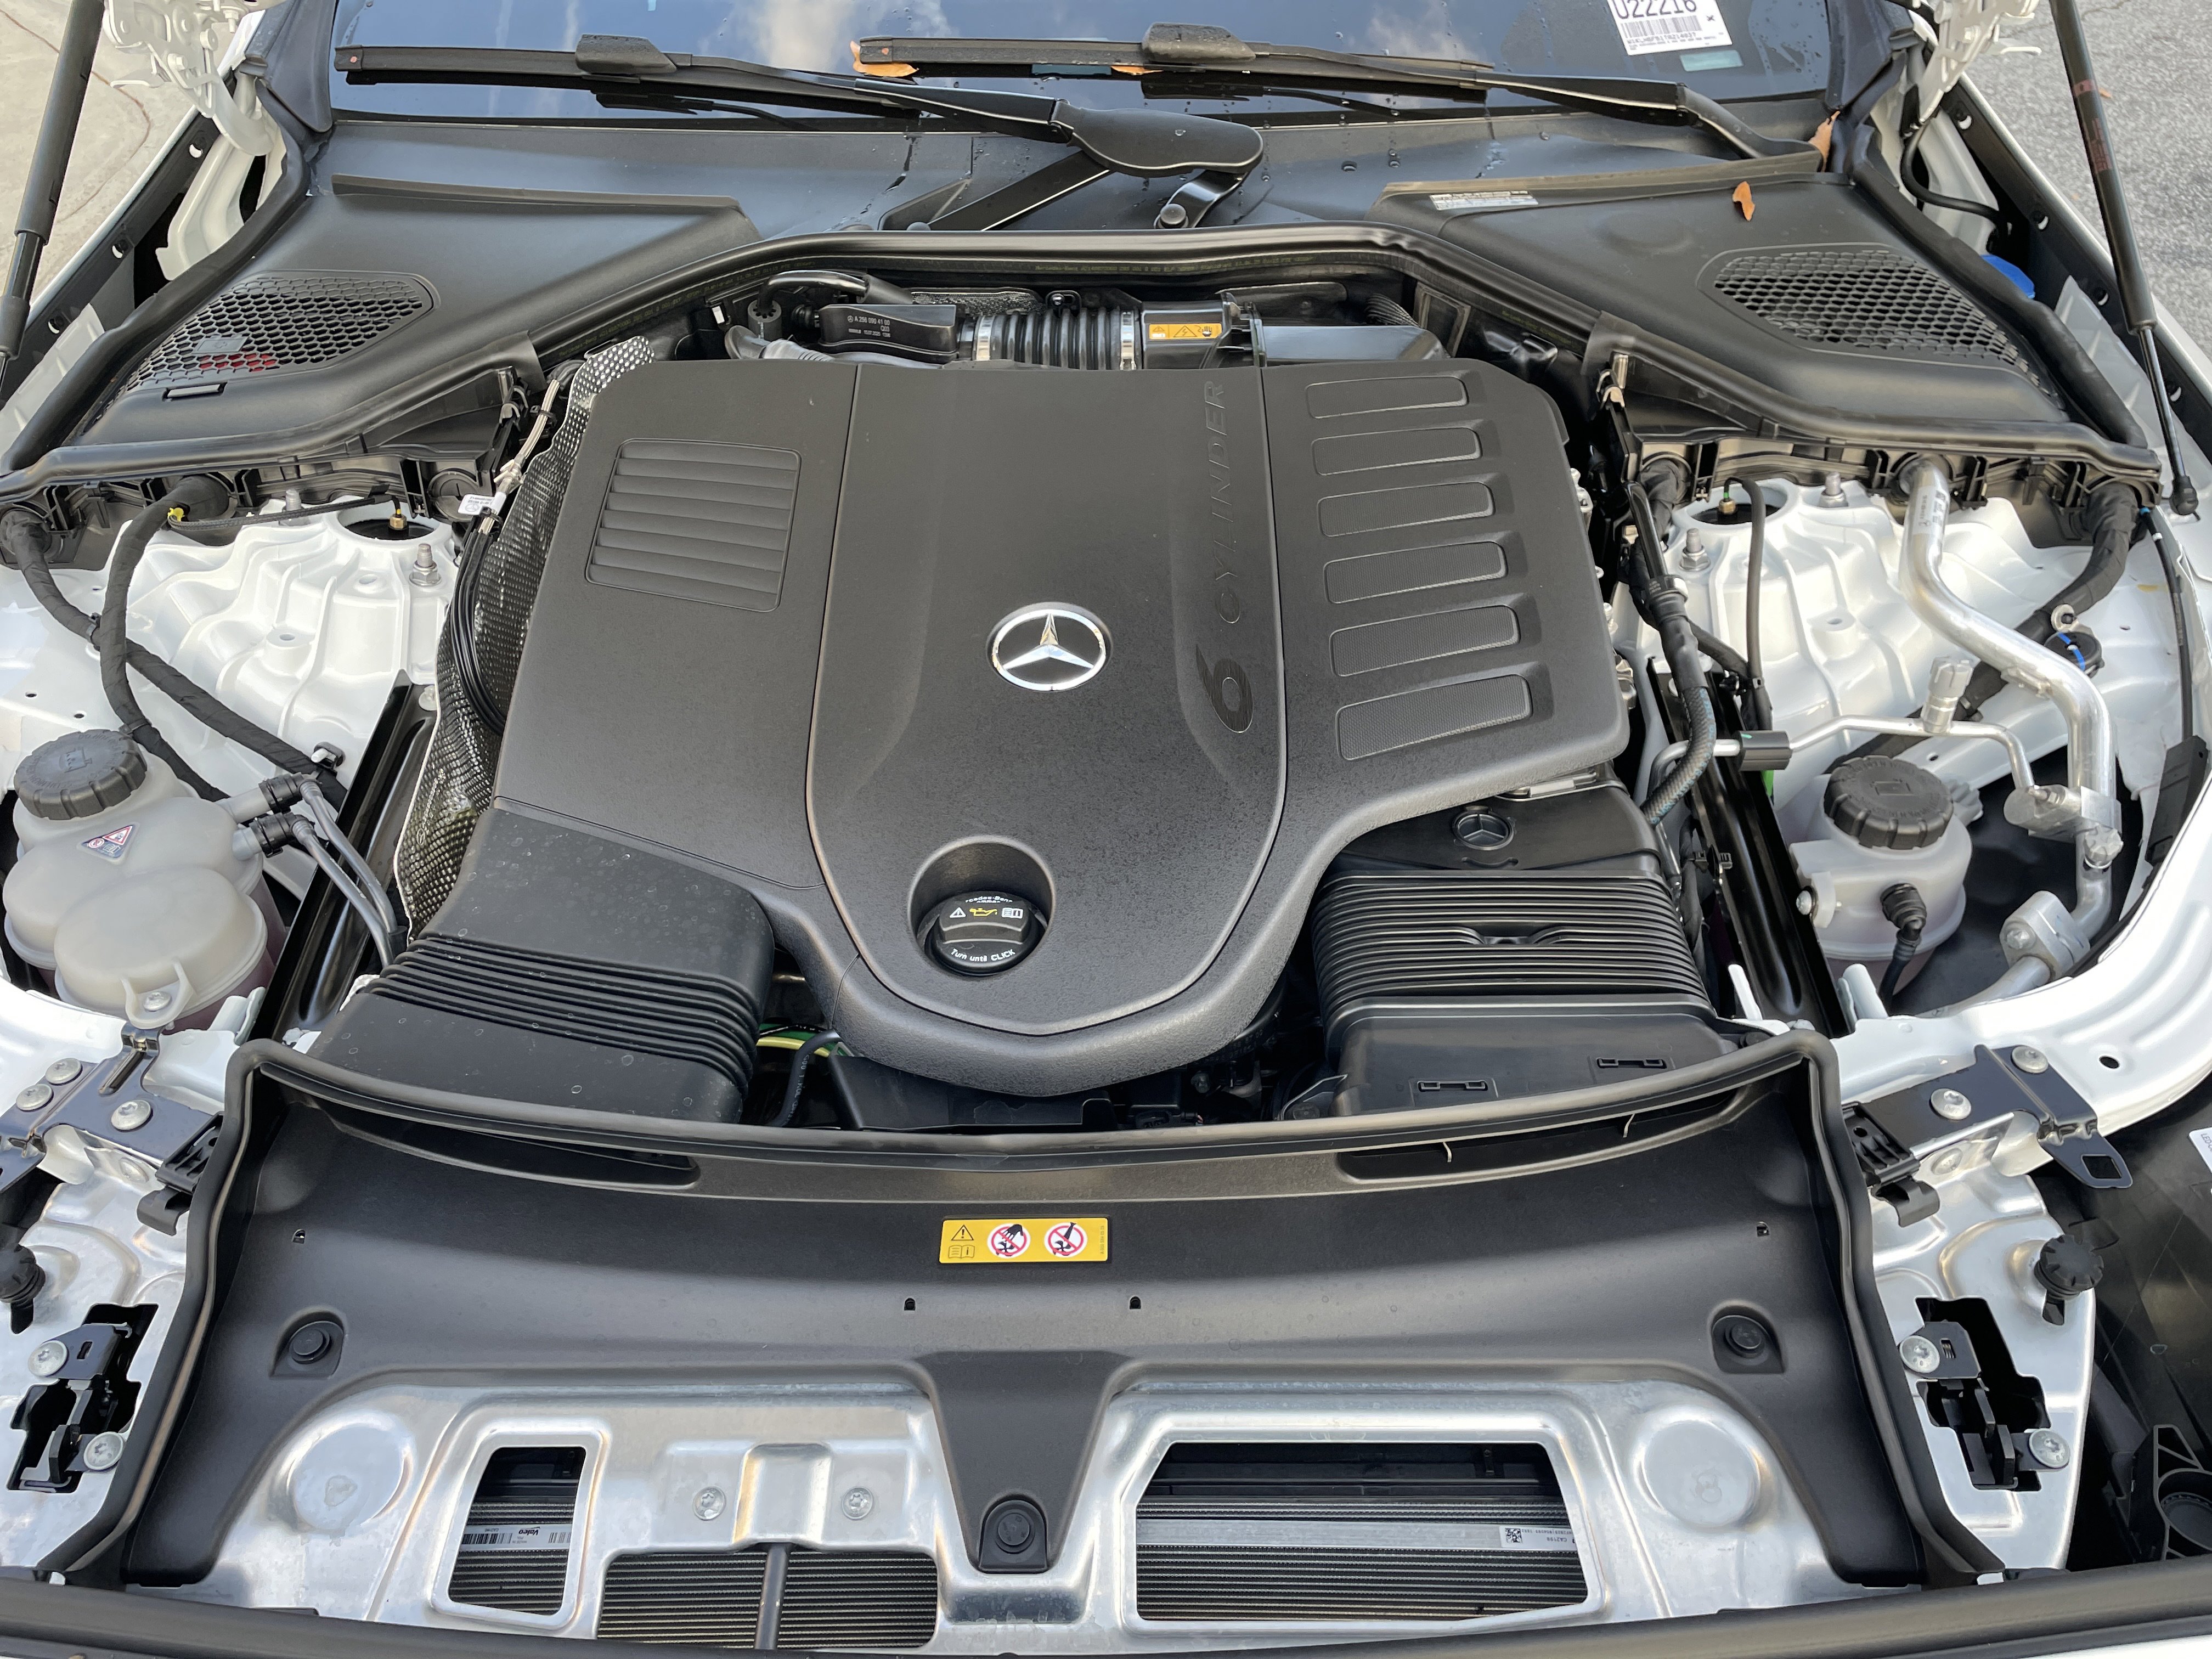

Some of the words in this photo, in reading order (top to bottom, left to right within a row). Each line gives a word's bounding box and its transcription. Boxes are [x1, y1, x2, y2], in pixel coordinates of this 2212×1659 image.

[1204, 381, 1241, 624] CYLINDER
[951, 948, 967, 960] Turn
[991, 949, 1015, 961] CLICK
